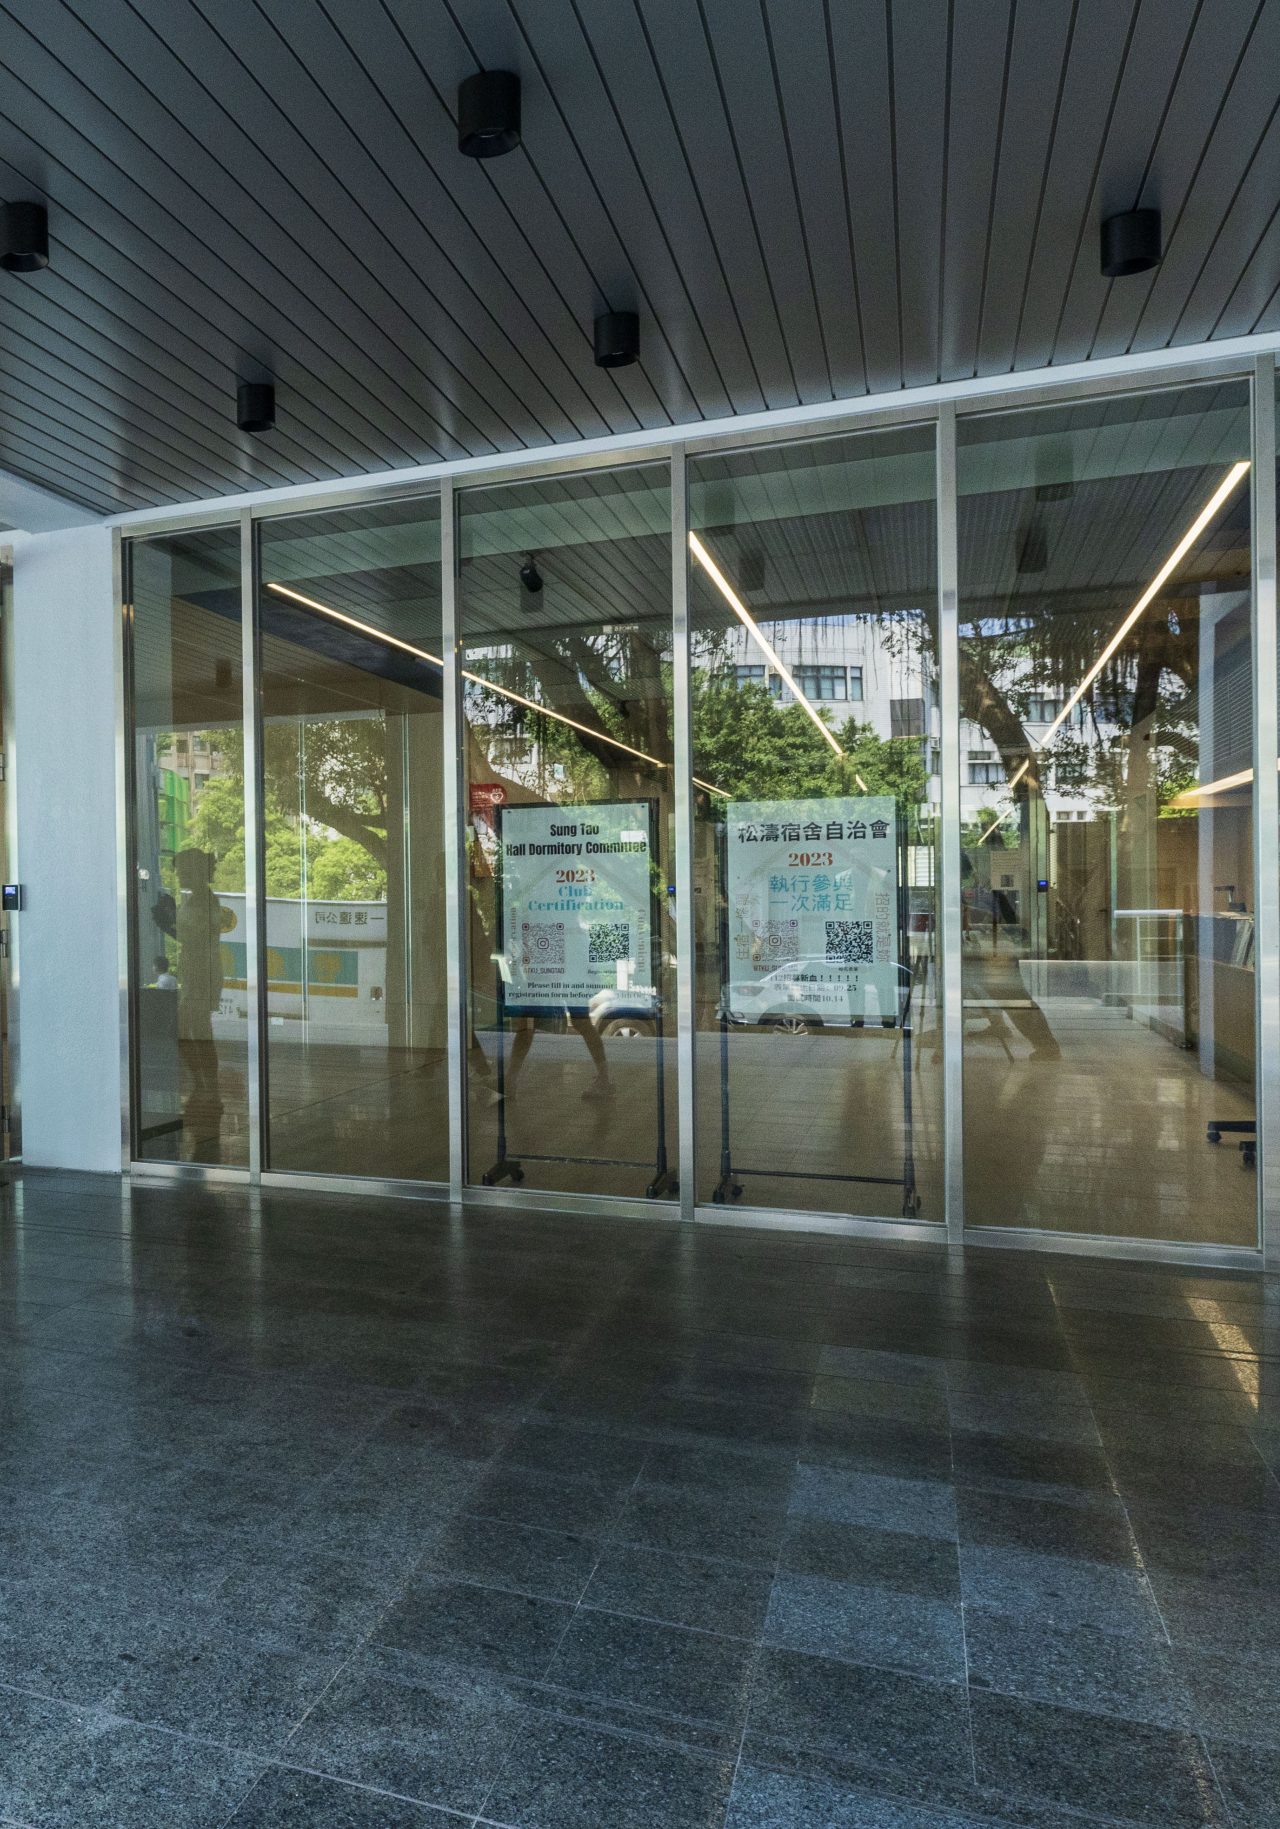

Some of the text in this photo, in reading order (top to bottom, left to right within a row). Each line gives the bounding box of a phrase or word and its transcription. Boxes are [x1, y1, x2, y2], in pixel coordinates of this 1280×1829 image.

[550, 823, 600, 837] Sung Tao
[738, 819, 890, 843] 松濤宿舍自治會
[506, 841, 647, 856] Hall Dormitory Committee
[788, 852, 833, 867] 2023
[556, 869, 596, 883] 2023
[558, 886, 593, 897] Club
[528, 899, 625, 911] Certification
[770, 893, 854, 912] 一次滿足
